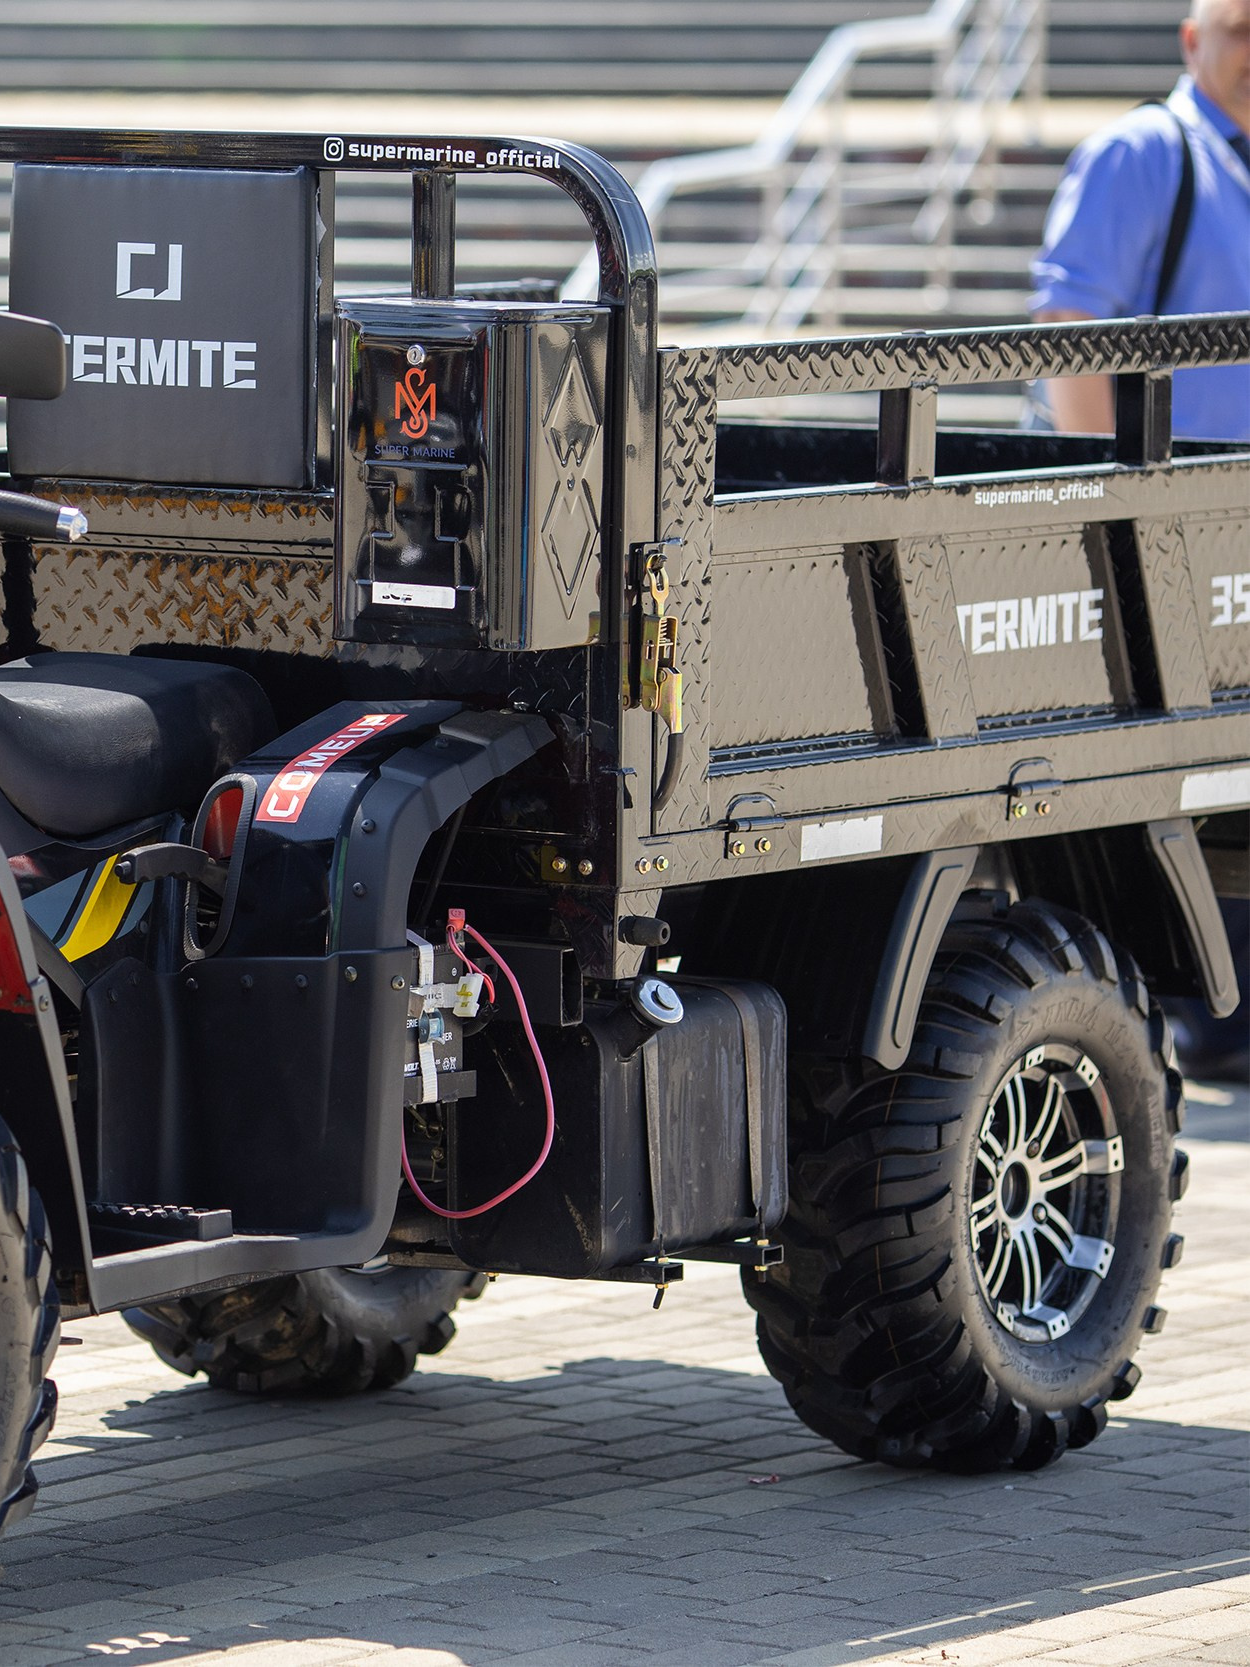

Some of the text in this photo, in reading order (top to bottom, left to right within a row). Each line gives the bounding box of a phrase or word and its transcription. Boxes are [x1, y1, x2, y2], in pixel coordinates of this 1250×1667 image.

[348, 142, 561, 169] supermarine_official
[115, 241, 182, 300] CJ
[374, 444, 456, 459] SUPER MARINE
